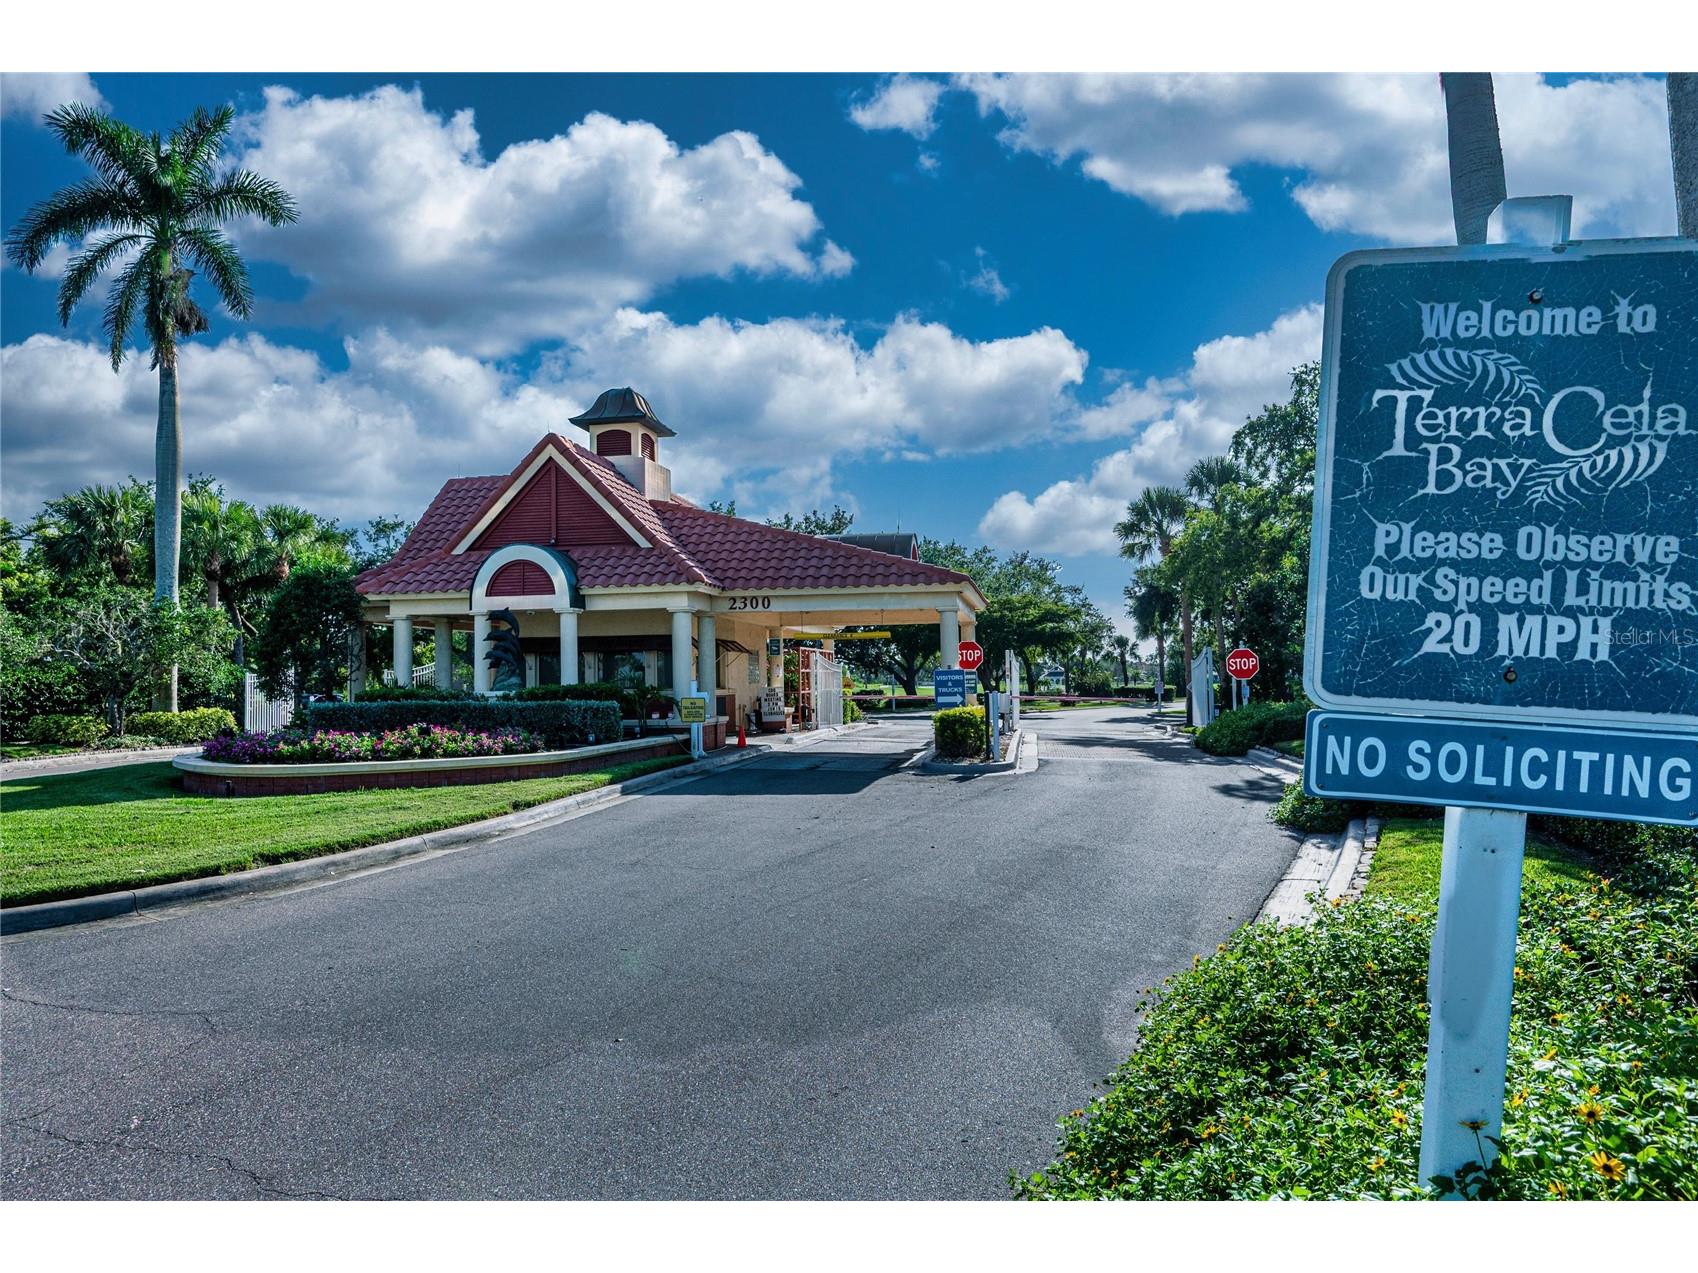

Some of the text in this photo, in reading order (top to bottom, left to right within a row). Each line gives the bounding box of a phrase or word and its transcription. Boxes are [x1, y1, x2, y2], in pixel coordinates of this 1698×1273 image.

[1420, 299, 1657, 338] Welcome to
[1371, 388, 1539, 457] Terra
[1420, 442, 1538, 500] Bay
[1374, 522, 1680, 564] Please Observe
[728, 596, 771, 610] 2300
[1360, 565, 1691, 612] Our Speed Limits
[958, 650, 981, 662] STOP
[1424, 611, 1612, 662] 20 MPH
[1229, 658, 1257, 670] STOP
[1325, 734, 1692, 802] NO SOLICITING
